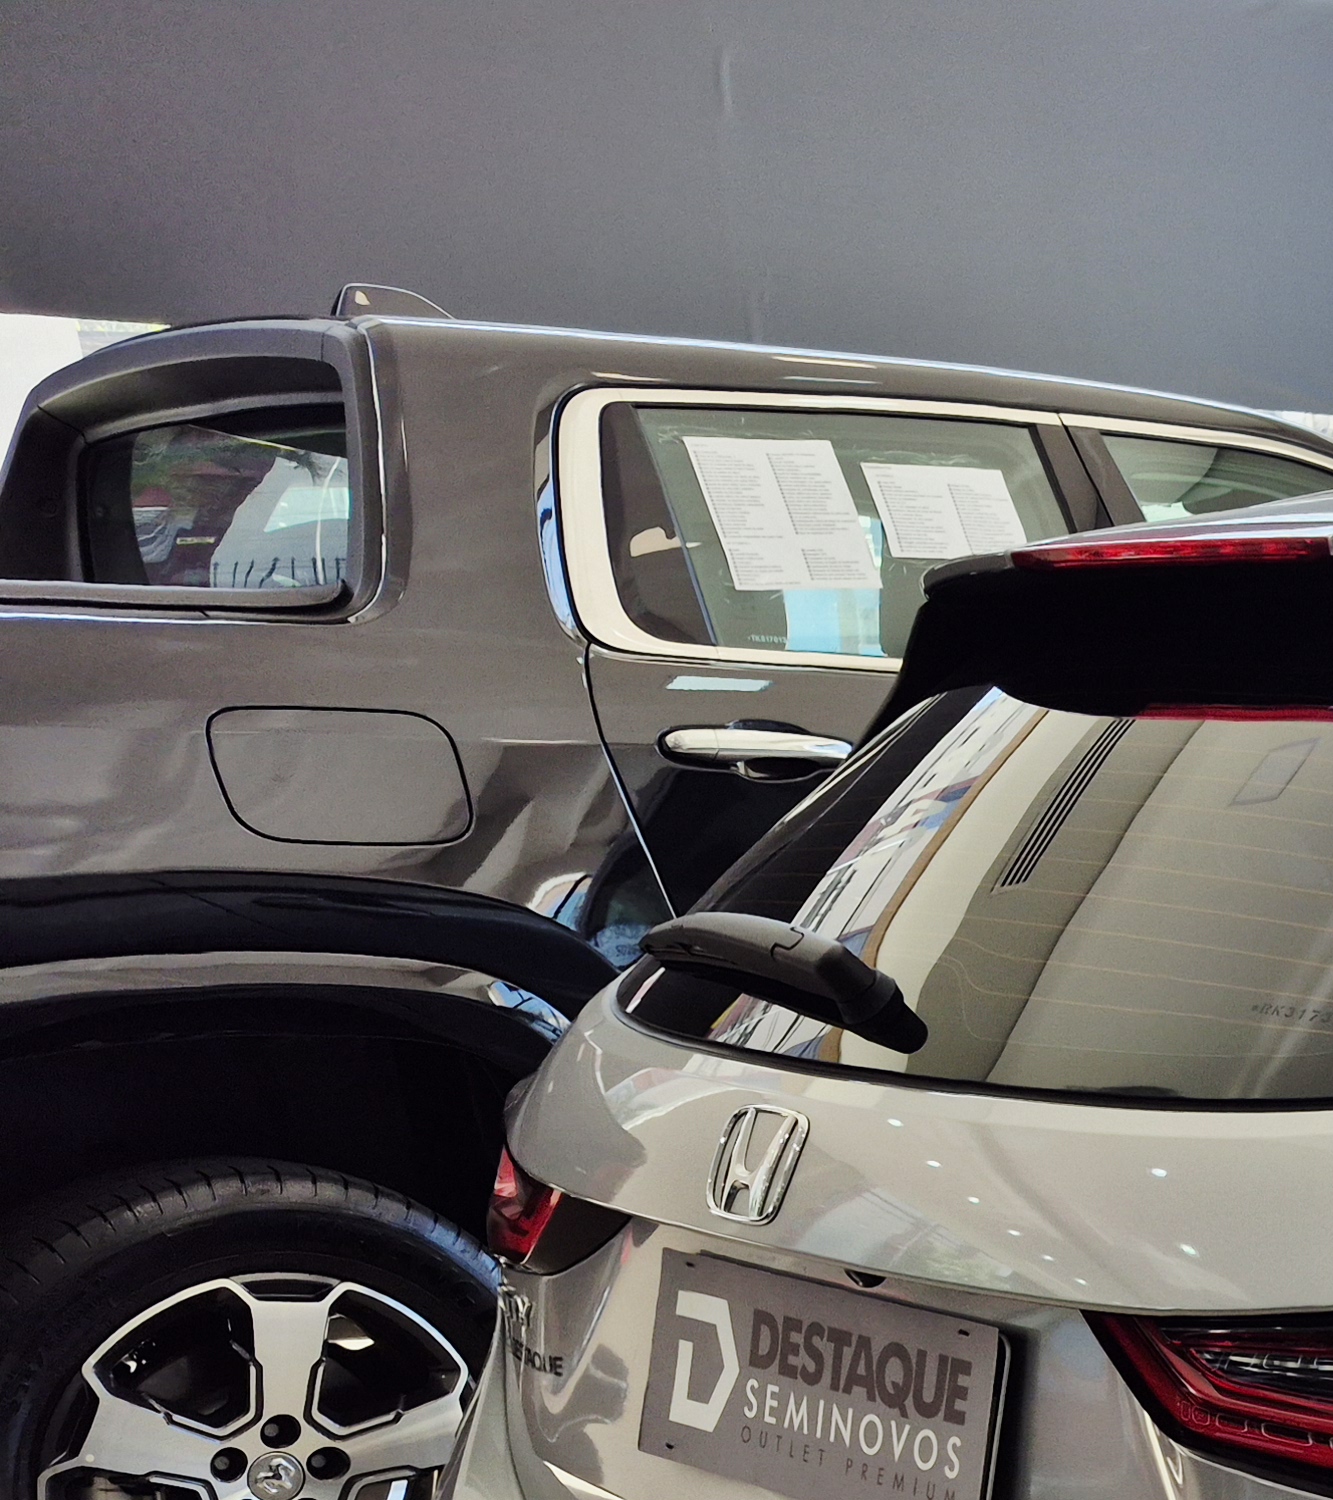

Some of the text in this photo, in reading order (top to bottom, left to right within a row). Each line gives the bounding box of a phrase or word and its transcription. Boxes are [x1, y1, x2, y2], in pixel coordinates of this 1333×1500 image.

[748, 1308, 973, 1426] DESTAQUE
[740, 1425, 826, 1468] OUTLET
[743, 1378, 962, 1479] SEMINOVOS
